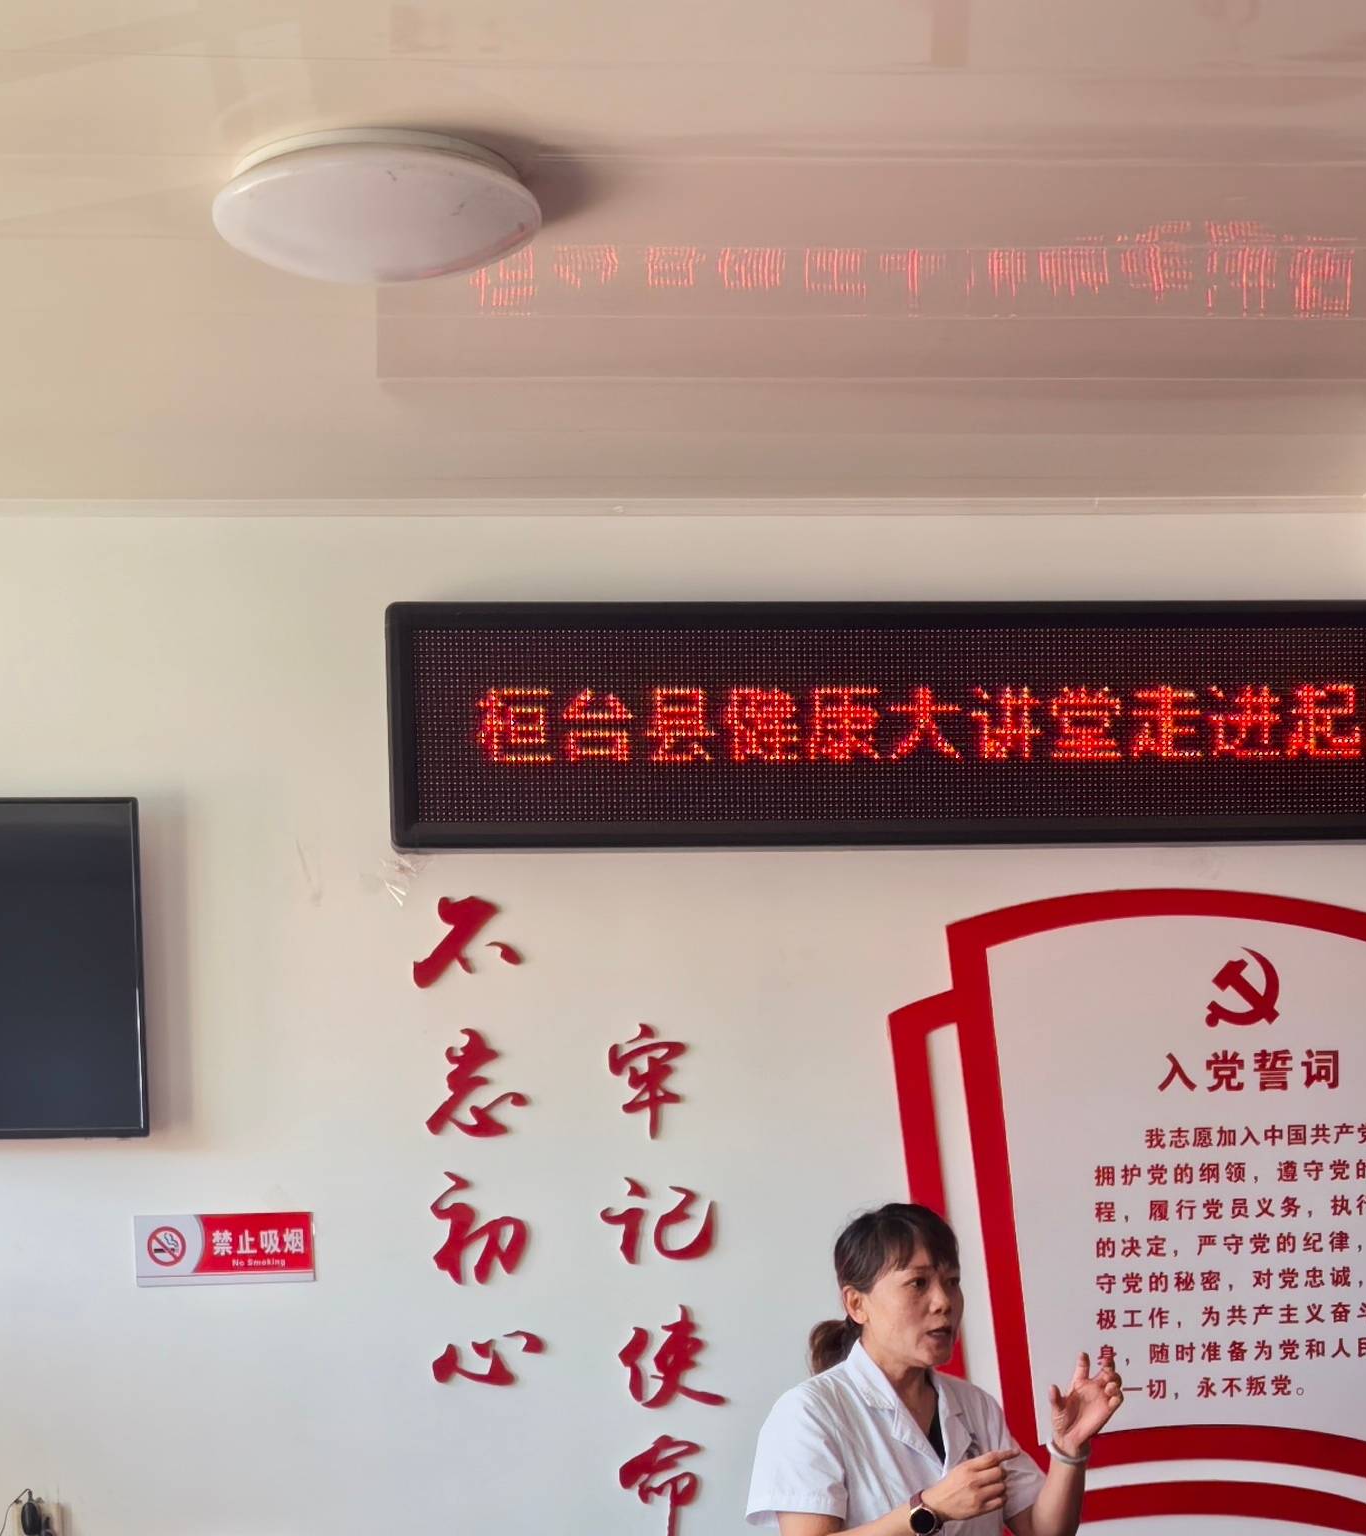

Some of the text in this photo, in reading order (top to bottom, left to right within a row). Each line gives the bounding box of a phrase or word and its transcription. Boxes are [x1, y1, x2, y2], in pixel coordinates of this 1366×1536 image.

[1157, 1047, 1341, 1096] 入党誓词
[411, 895, 546, 1387] 不忘初心
[211, 1228, 305, 1257] 禁止吸烟
[231, 1258, 286, 1268] No Smoking
[1122, 1374, 1306, 1400] 一切，永不叛党。
